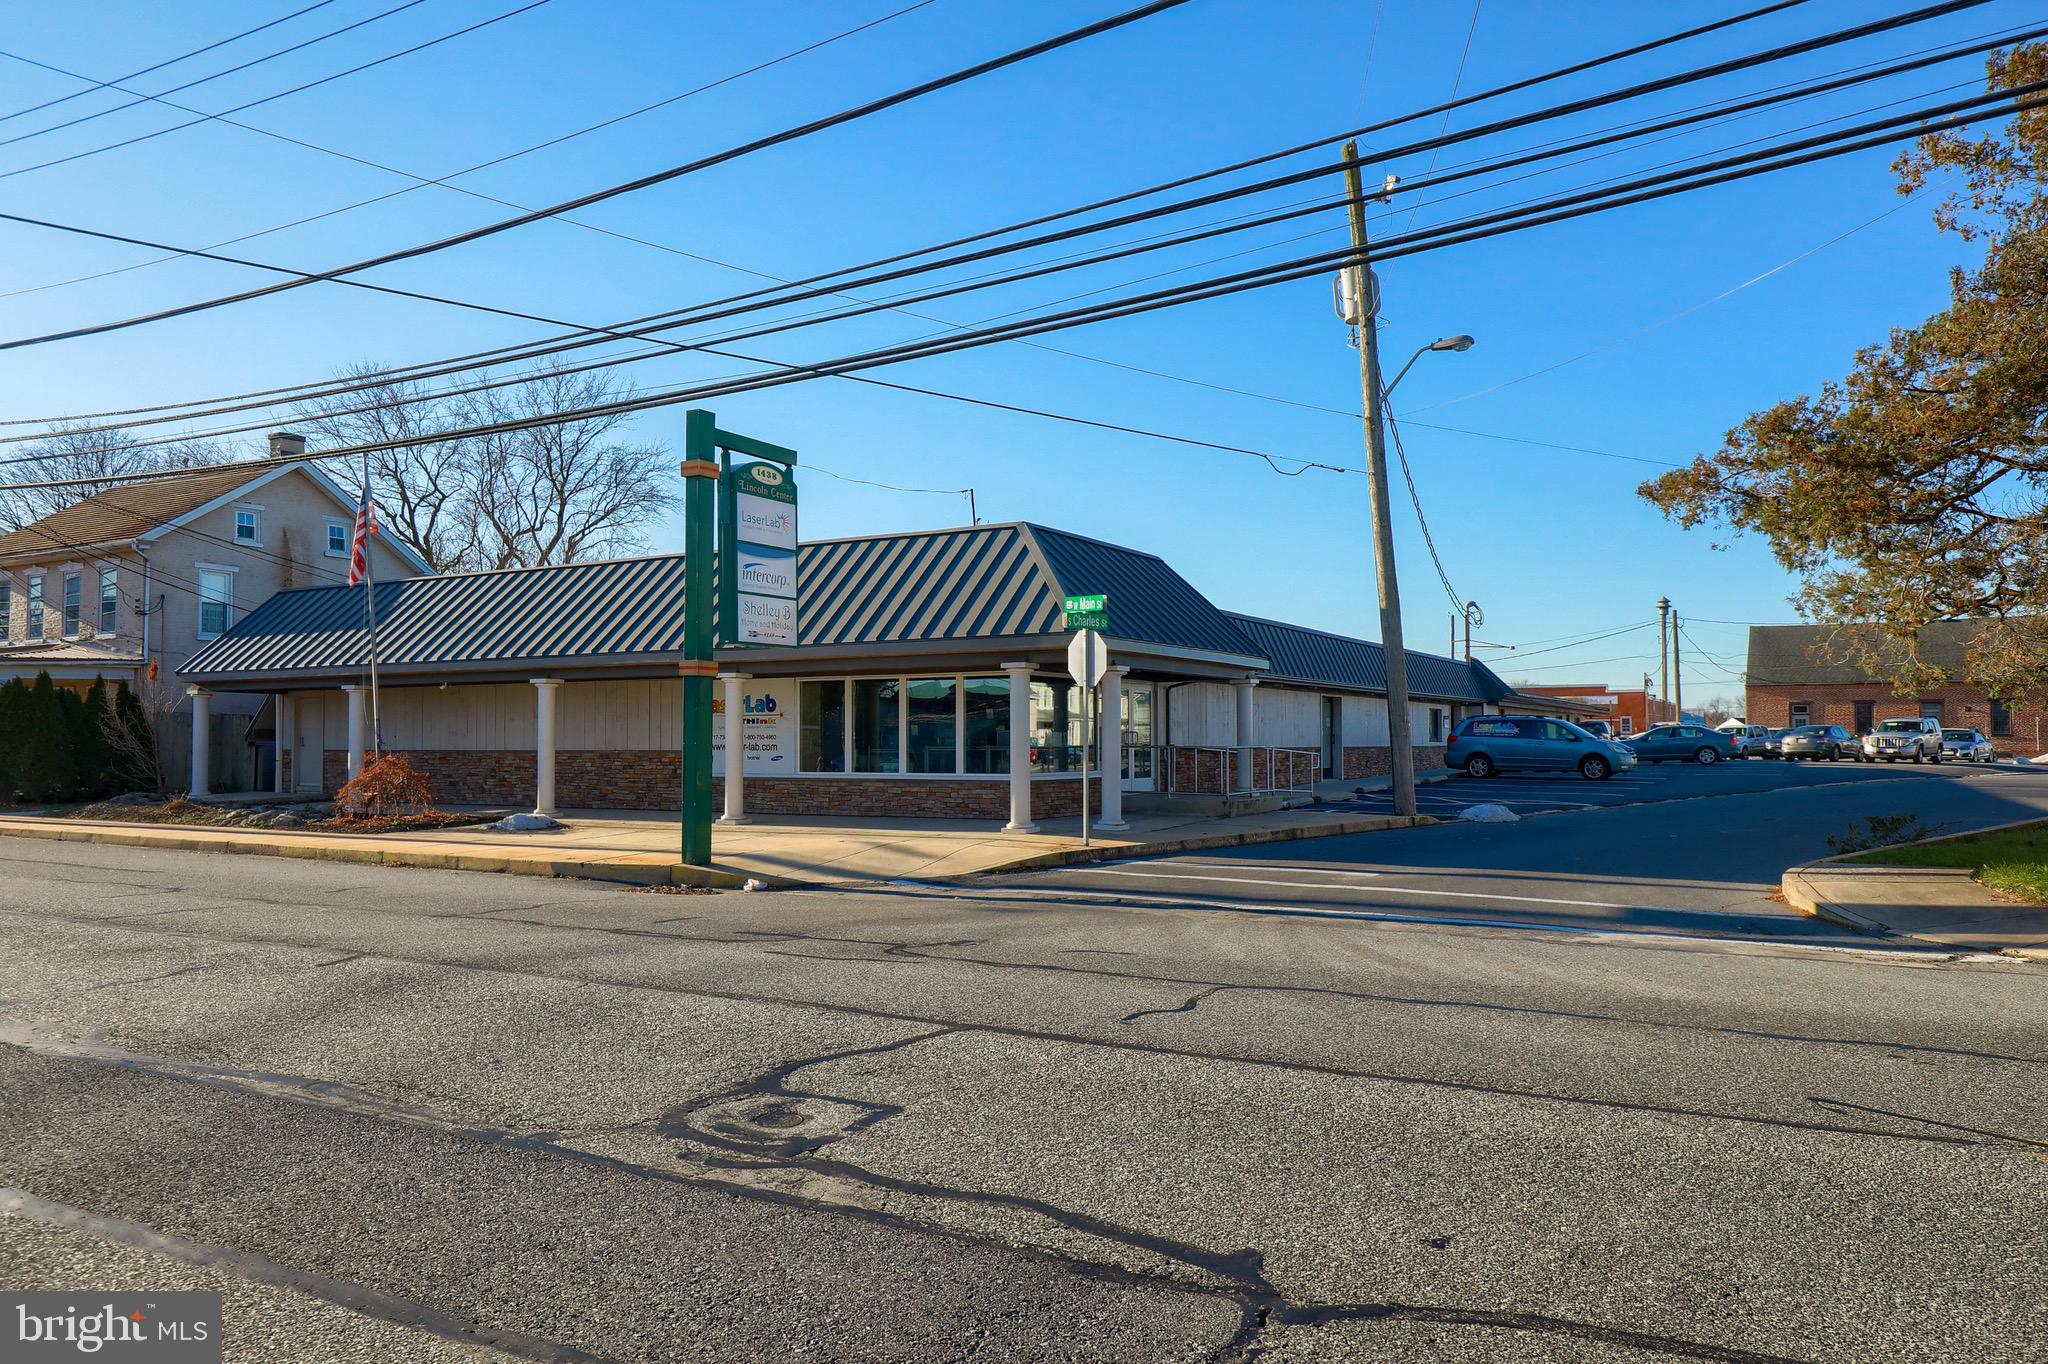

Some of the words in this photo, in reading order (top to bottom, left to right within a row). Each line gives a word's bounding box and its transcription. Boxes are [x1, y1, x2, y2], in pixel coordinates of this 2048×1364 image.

[757, 468, 777, 480] 1438
[738, 480, 769, 495] Lincoln
[771, 488, 793, 501] Center
[741, 510, 781, 528] LaserLab
[742, 567, 787, 589] intercorp
[743, 601, 780, 621] Shelley
[783, 605, 791, 620] B
[1080, 597, 1095, 610] Main
[771, 621, 794, 632] Holiday
[1073, 614, 1100, 627] Charles
